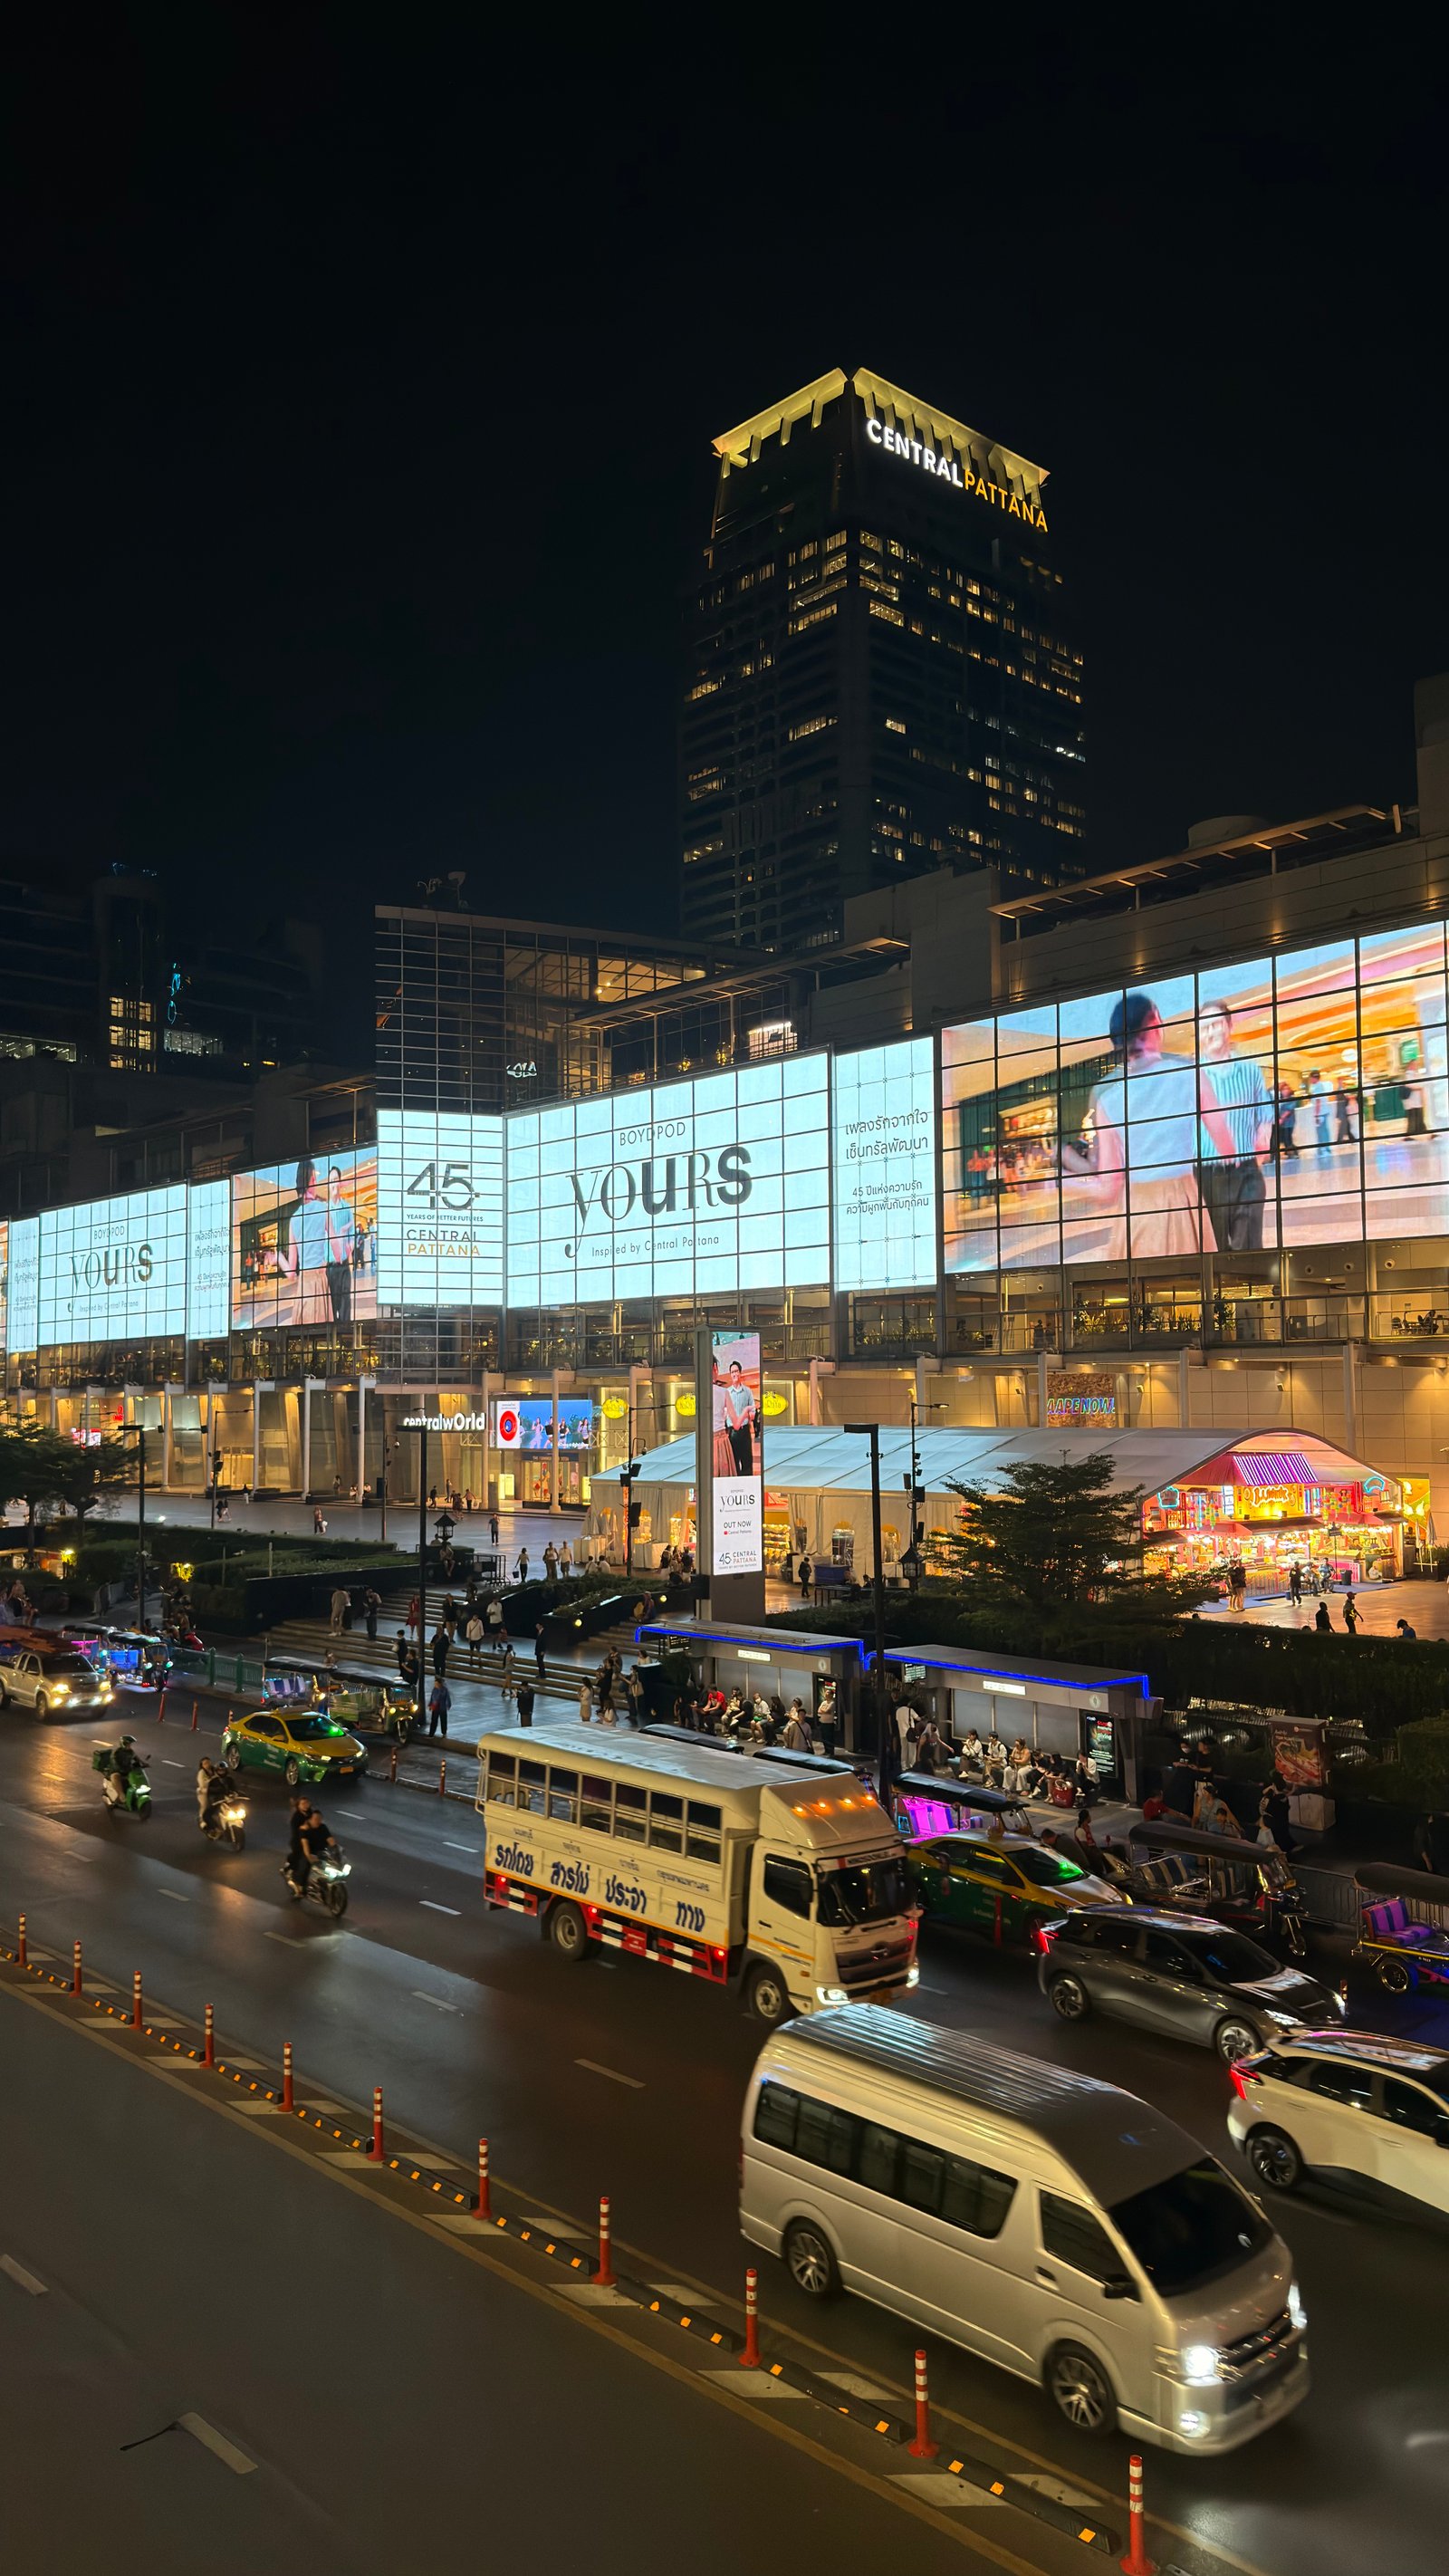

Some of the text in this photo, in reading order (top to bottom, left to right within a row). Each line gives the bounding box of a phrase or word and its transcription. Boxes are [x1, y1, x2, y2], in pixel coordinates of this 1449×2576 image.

[866, 418, 1049, 533] CENTRAL PATTANA
[846, 1109, 928, 1135] เพลงรักจากใจ
[619, 1122, 686, 1146] BOYDPOD
[846, 1137, 928, 1159] เซ็นทรัลพัฒนา
[407, 1163, 480, 1211] 45
[852, 1187, 864, 1197] 45
[407, 1229, 480, 1243] CENTRAL
[408, 1243, 480, 1255] PATTANA
[591, 1243, 627, 1258] Inspied
[630, 1242, 640, 1254] by
[682, 1236, 719, 1247] Patana
[724, 1520, 752, 1529] OUT NOW
[719, 1550, 757, 1565] 45 CENTRAL
[733, 1557, 757, 1565] PATTANA
